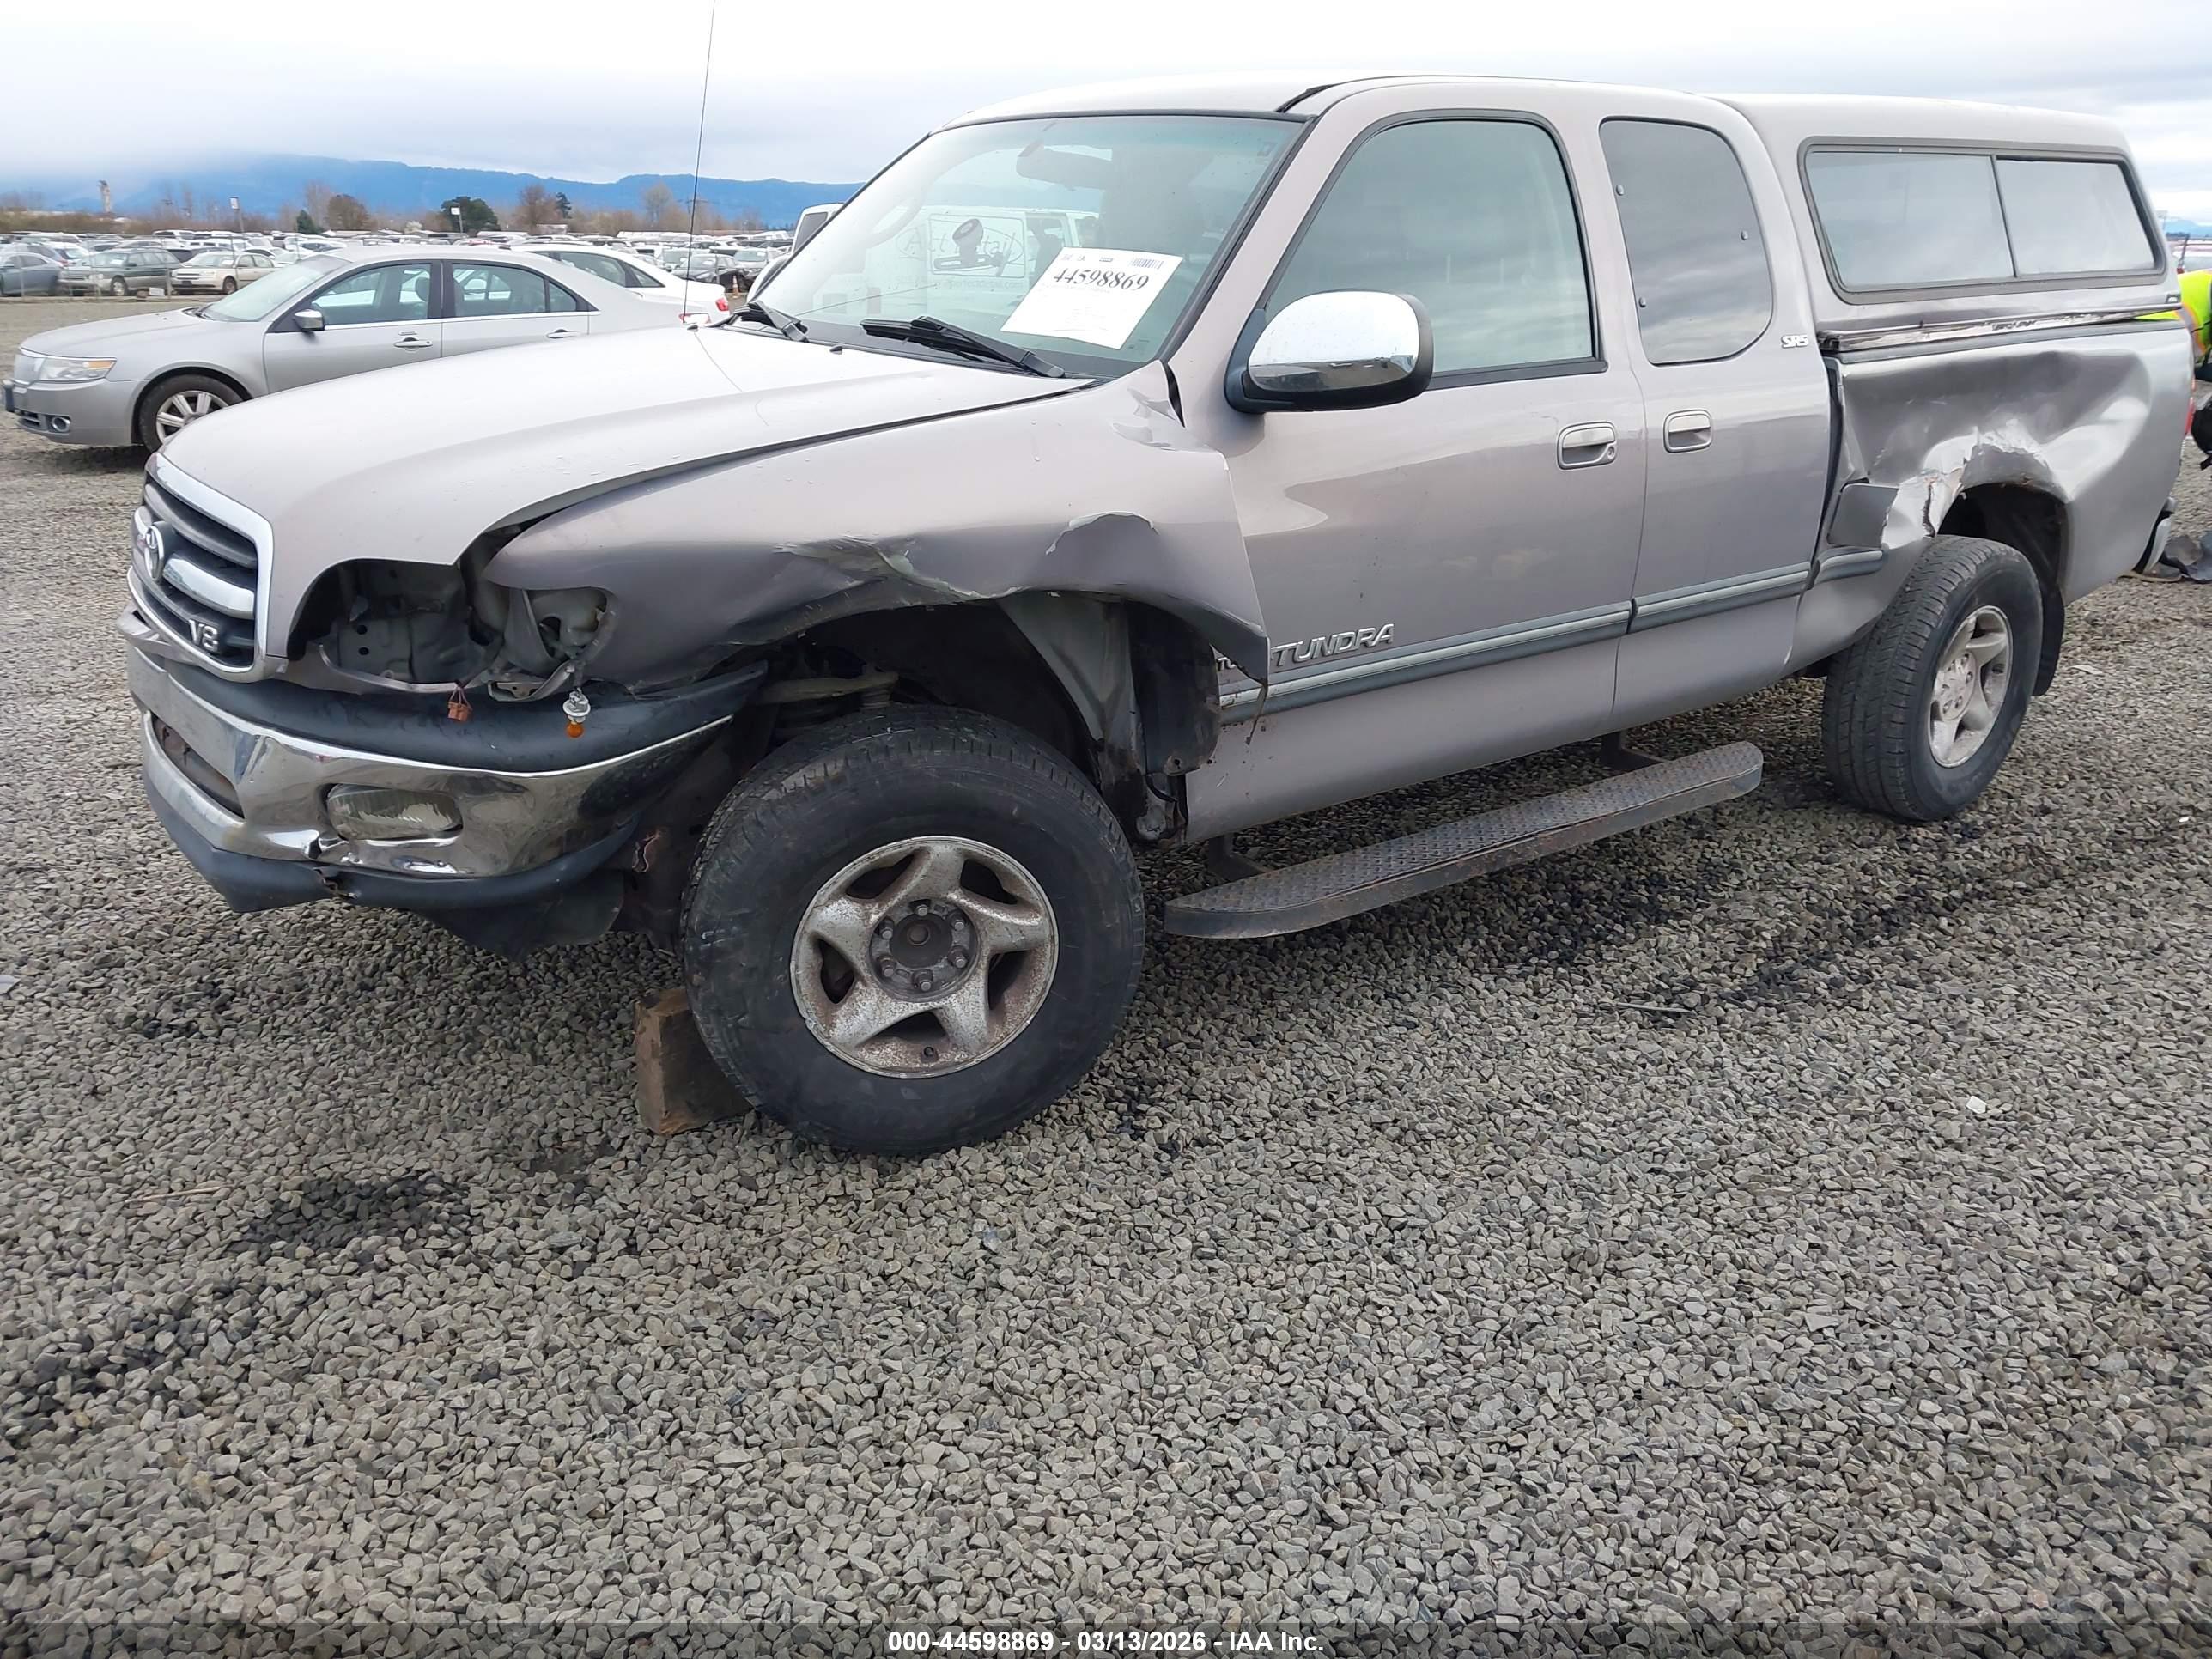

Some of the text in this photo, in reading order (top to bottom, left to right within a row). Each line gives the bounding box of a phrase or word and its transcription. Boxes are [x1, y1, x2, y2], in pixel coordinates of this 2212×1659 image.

[1054, 267, 1149, 290] 44598869
[188, 619, 220, 653] V8
[1272, 623, 1395, 667] TUNDRA
